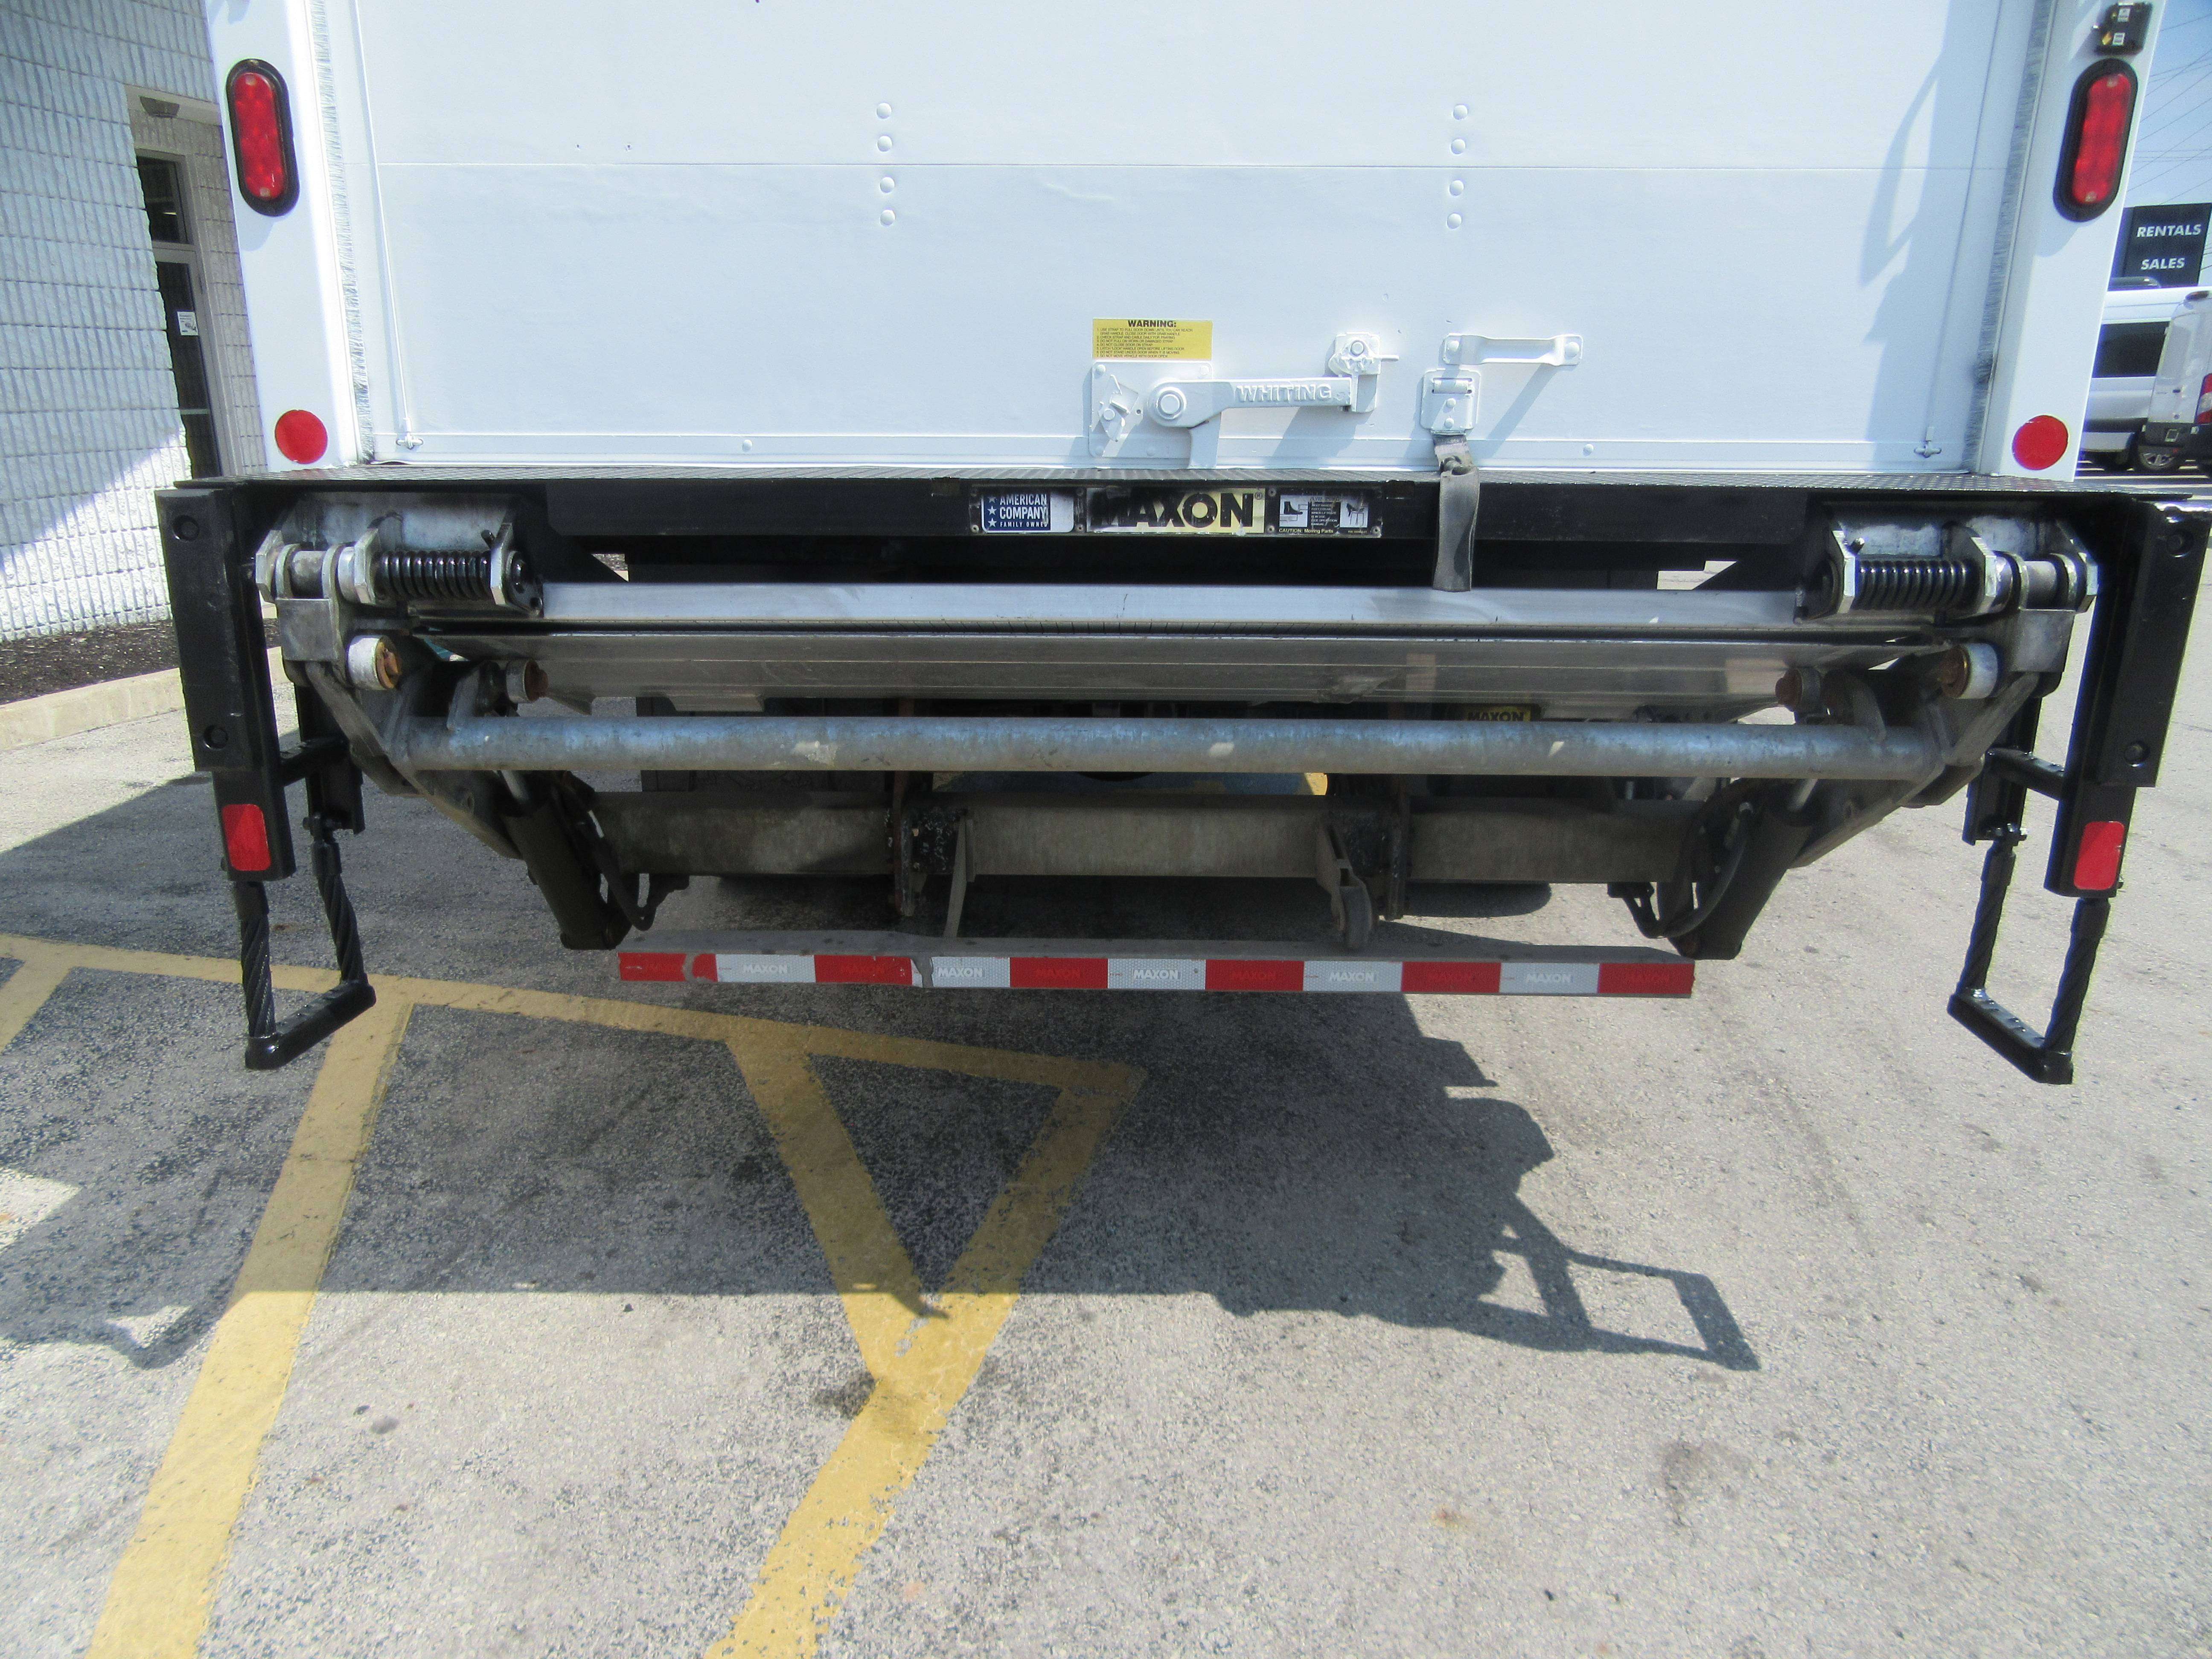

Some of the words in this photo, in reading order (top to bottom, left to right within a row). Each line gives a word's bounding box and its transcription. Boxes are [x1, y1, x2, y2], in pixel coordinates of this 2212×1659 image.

[2136, 224, 2201, 237] RENTALS
[2140, 258, 2185, 270] SALES
[1237, 384, 1332, 401] WHITING
[1000, 494, 1047, 505] AMERICAN
[999, 506, 1047, 519] COMPANY
[743, 963, 788, 973] MAXON
[938, 967, 982, 977] MAXON
[1133, 969, 1178, 980] MAXON
[1329, 972, 1374, 982] MAXON
[1526, 973, 1572, 983] MAXON
